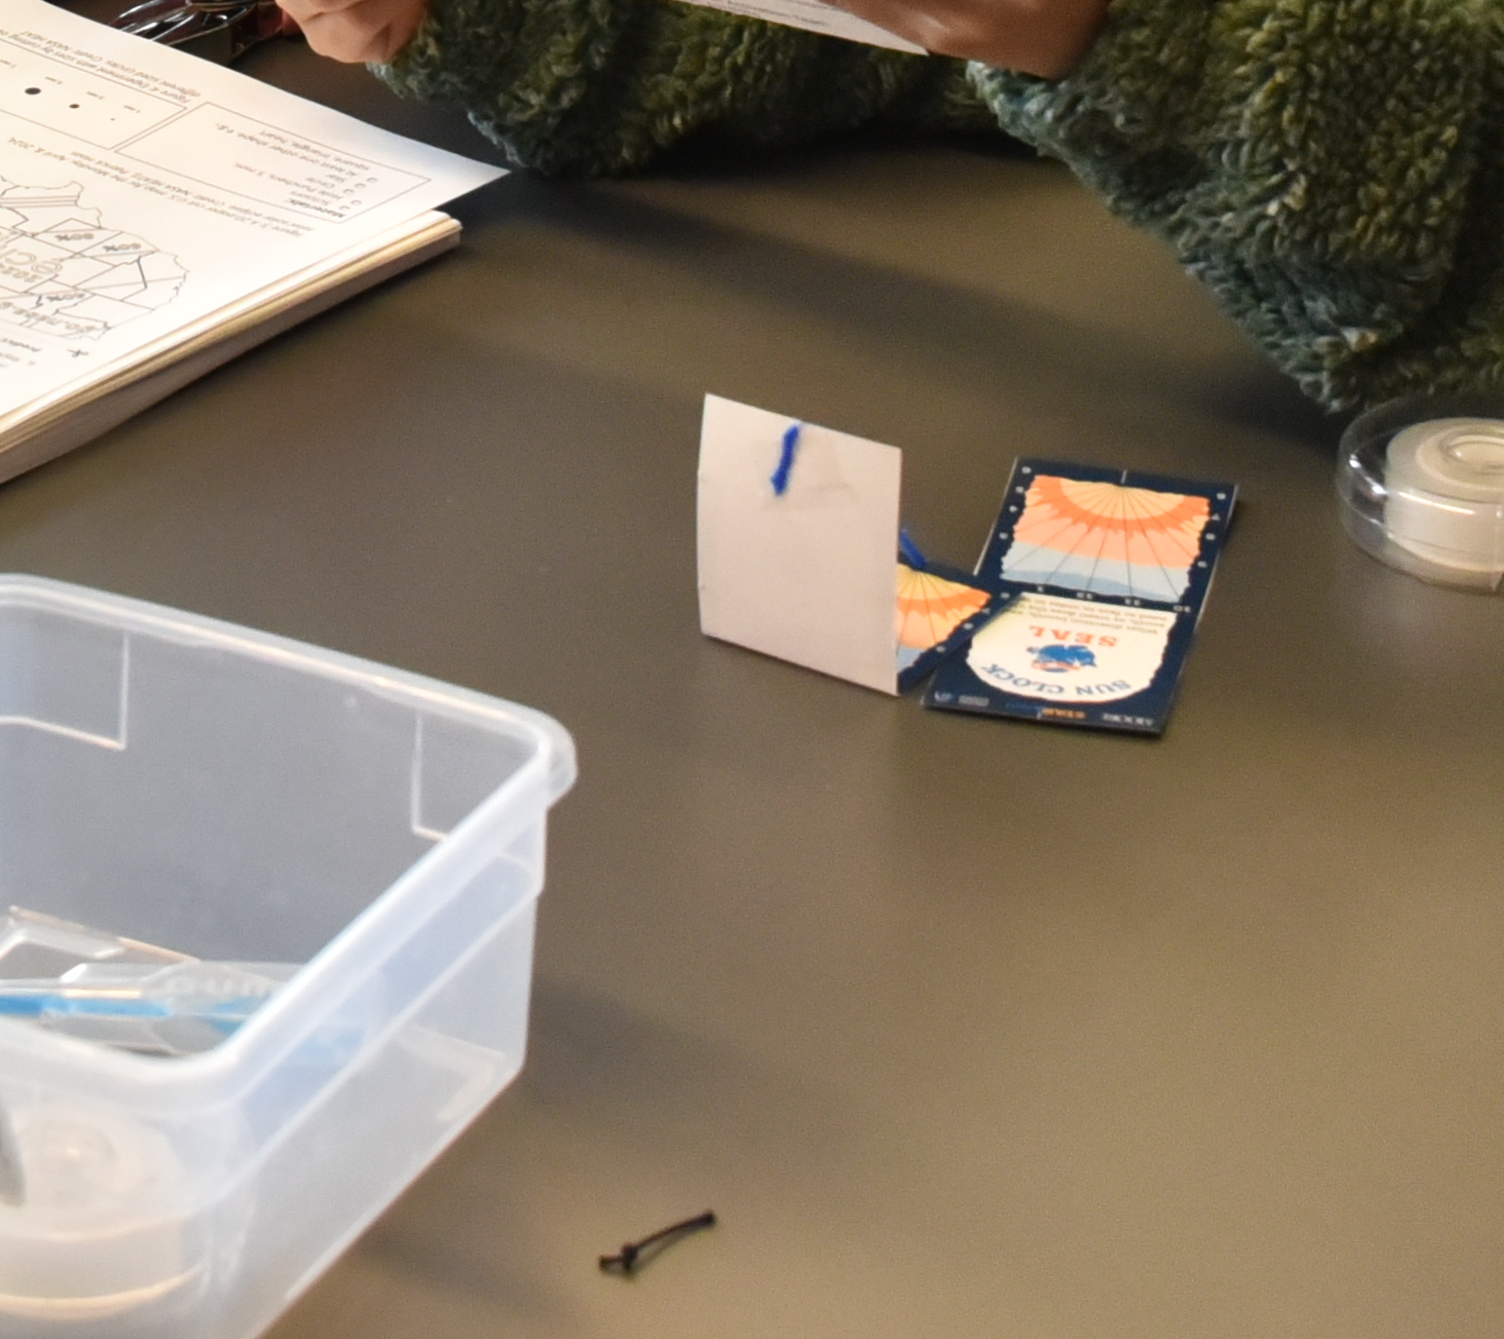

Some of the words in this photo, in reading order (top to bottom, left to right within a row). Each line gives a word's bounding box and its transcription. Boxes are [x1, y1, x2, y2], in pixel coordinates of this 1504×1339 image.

[1028, 625, 1117, 647] SEAL
[982, 663, 1065, 695] CLOCK
[1075, 679, 1131, 696] SUN
